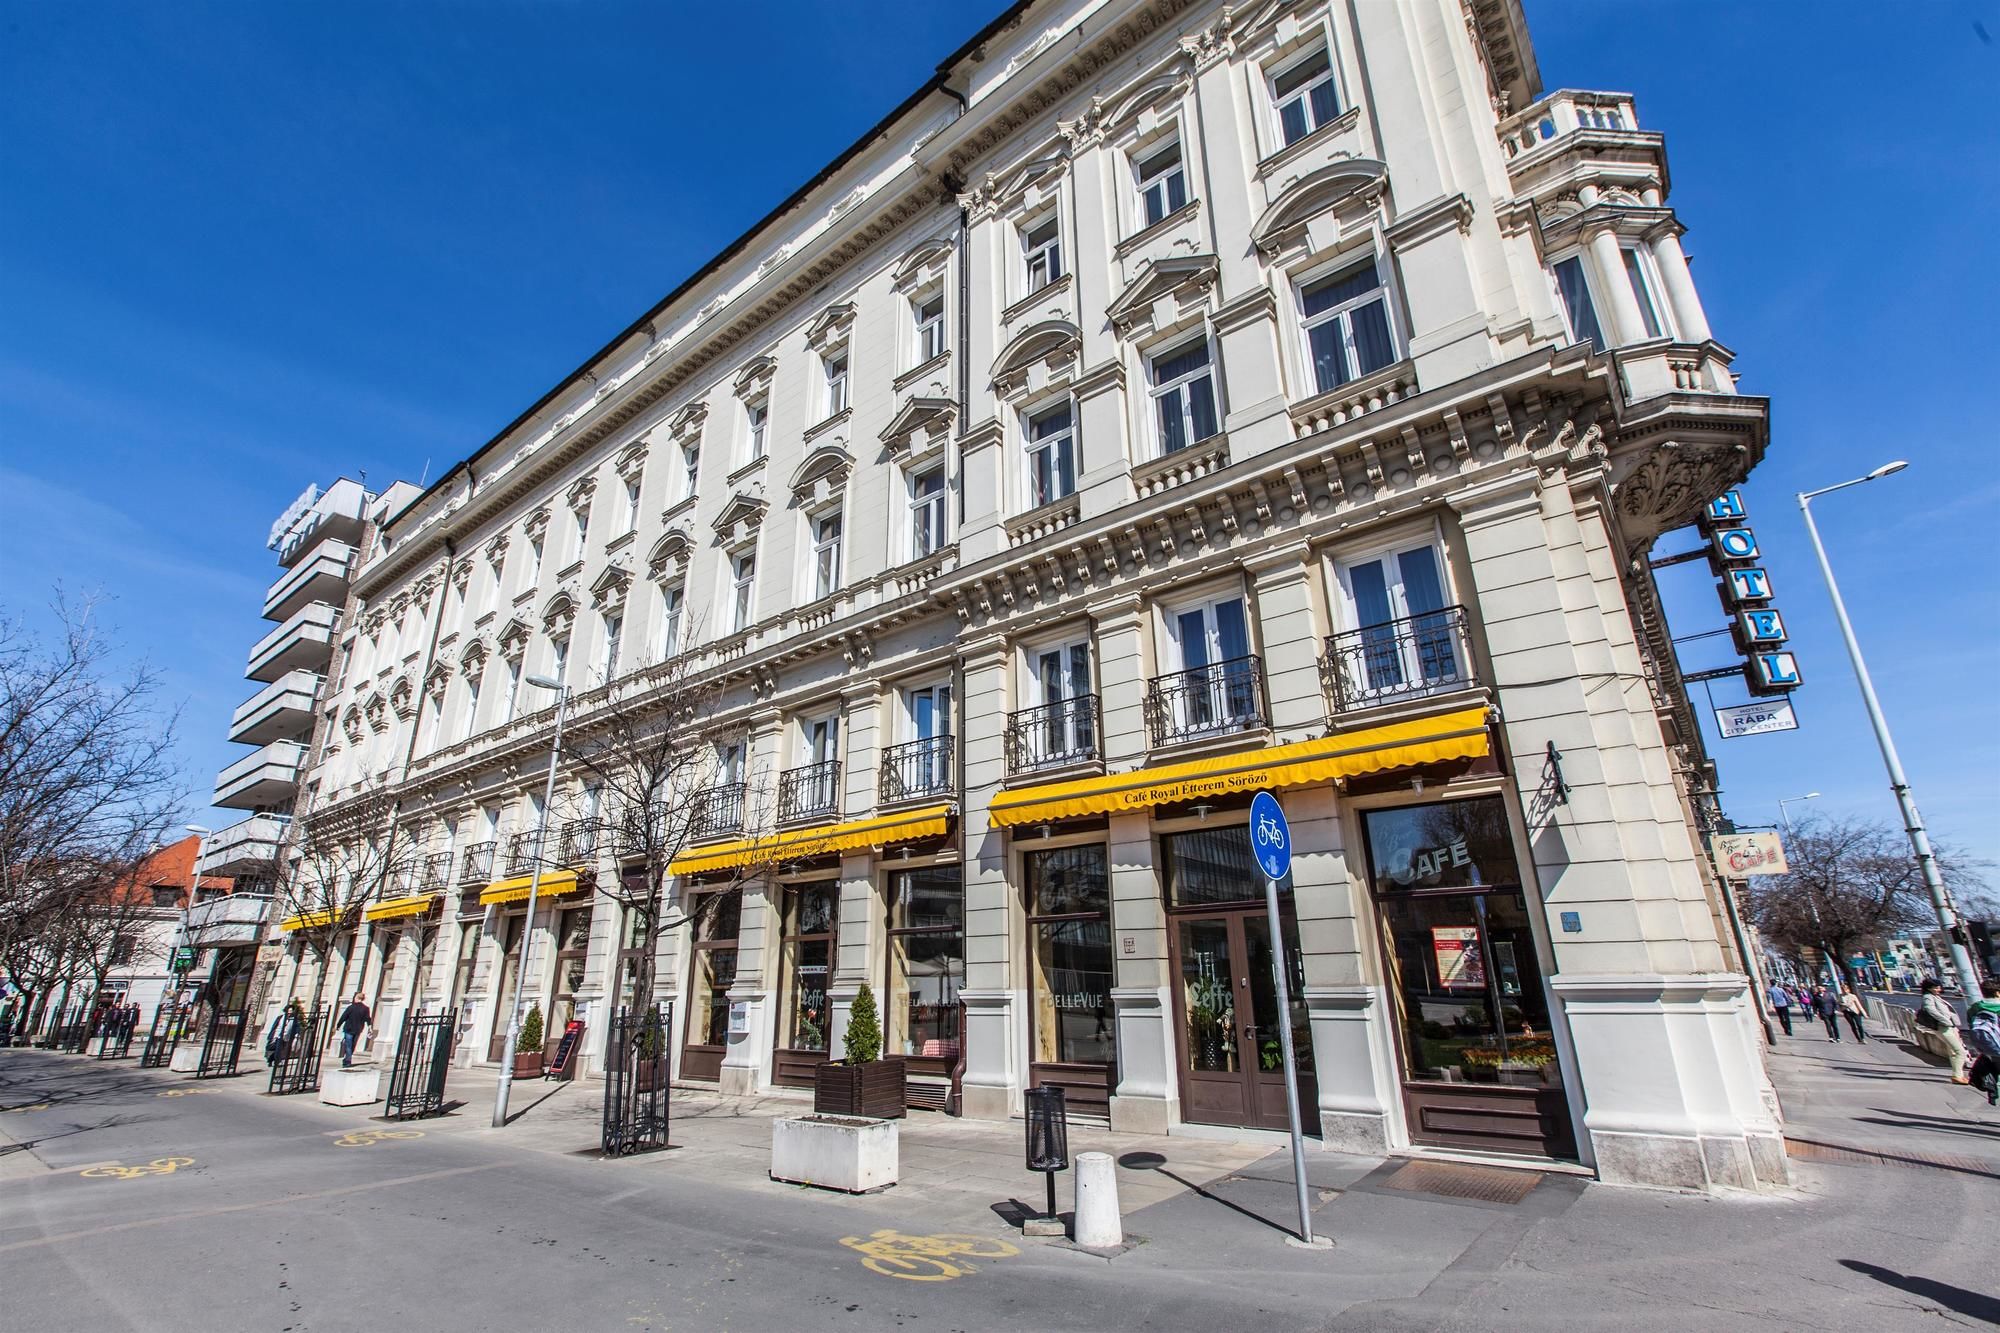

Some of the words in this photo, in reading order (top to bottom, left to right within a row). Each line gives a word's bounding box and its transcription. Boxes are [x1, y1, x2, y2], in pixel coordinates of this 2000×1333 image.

[1713, 491, 1796, 684] HOTEL
[1734, 713, 1777, 726] RÁBA
[1740, 706, 1765, 714] HOTEL
[1725, 727, 1747, 735] CITY
[1751, 721, 1792, 731] CENTER
[1124, 791, 1147, 804] Café
[1150, 786, 1179, 801] Royal
[1182, 781, 1225, 795] Étterem
[801, 988, 824, 1009] Leffe
[1189, 981, 1233, 1014] Leffe
